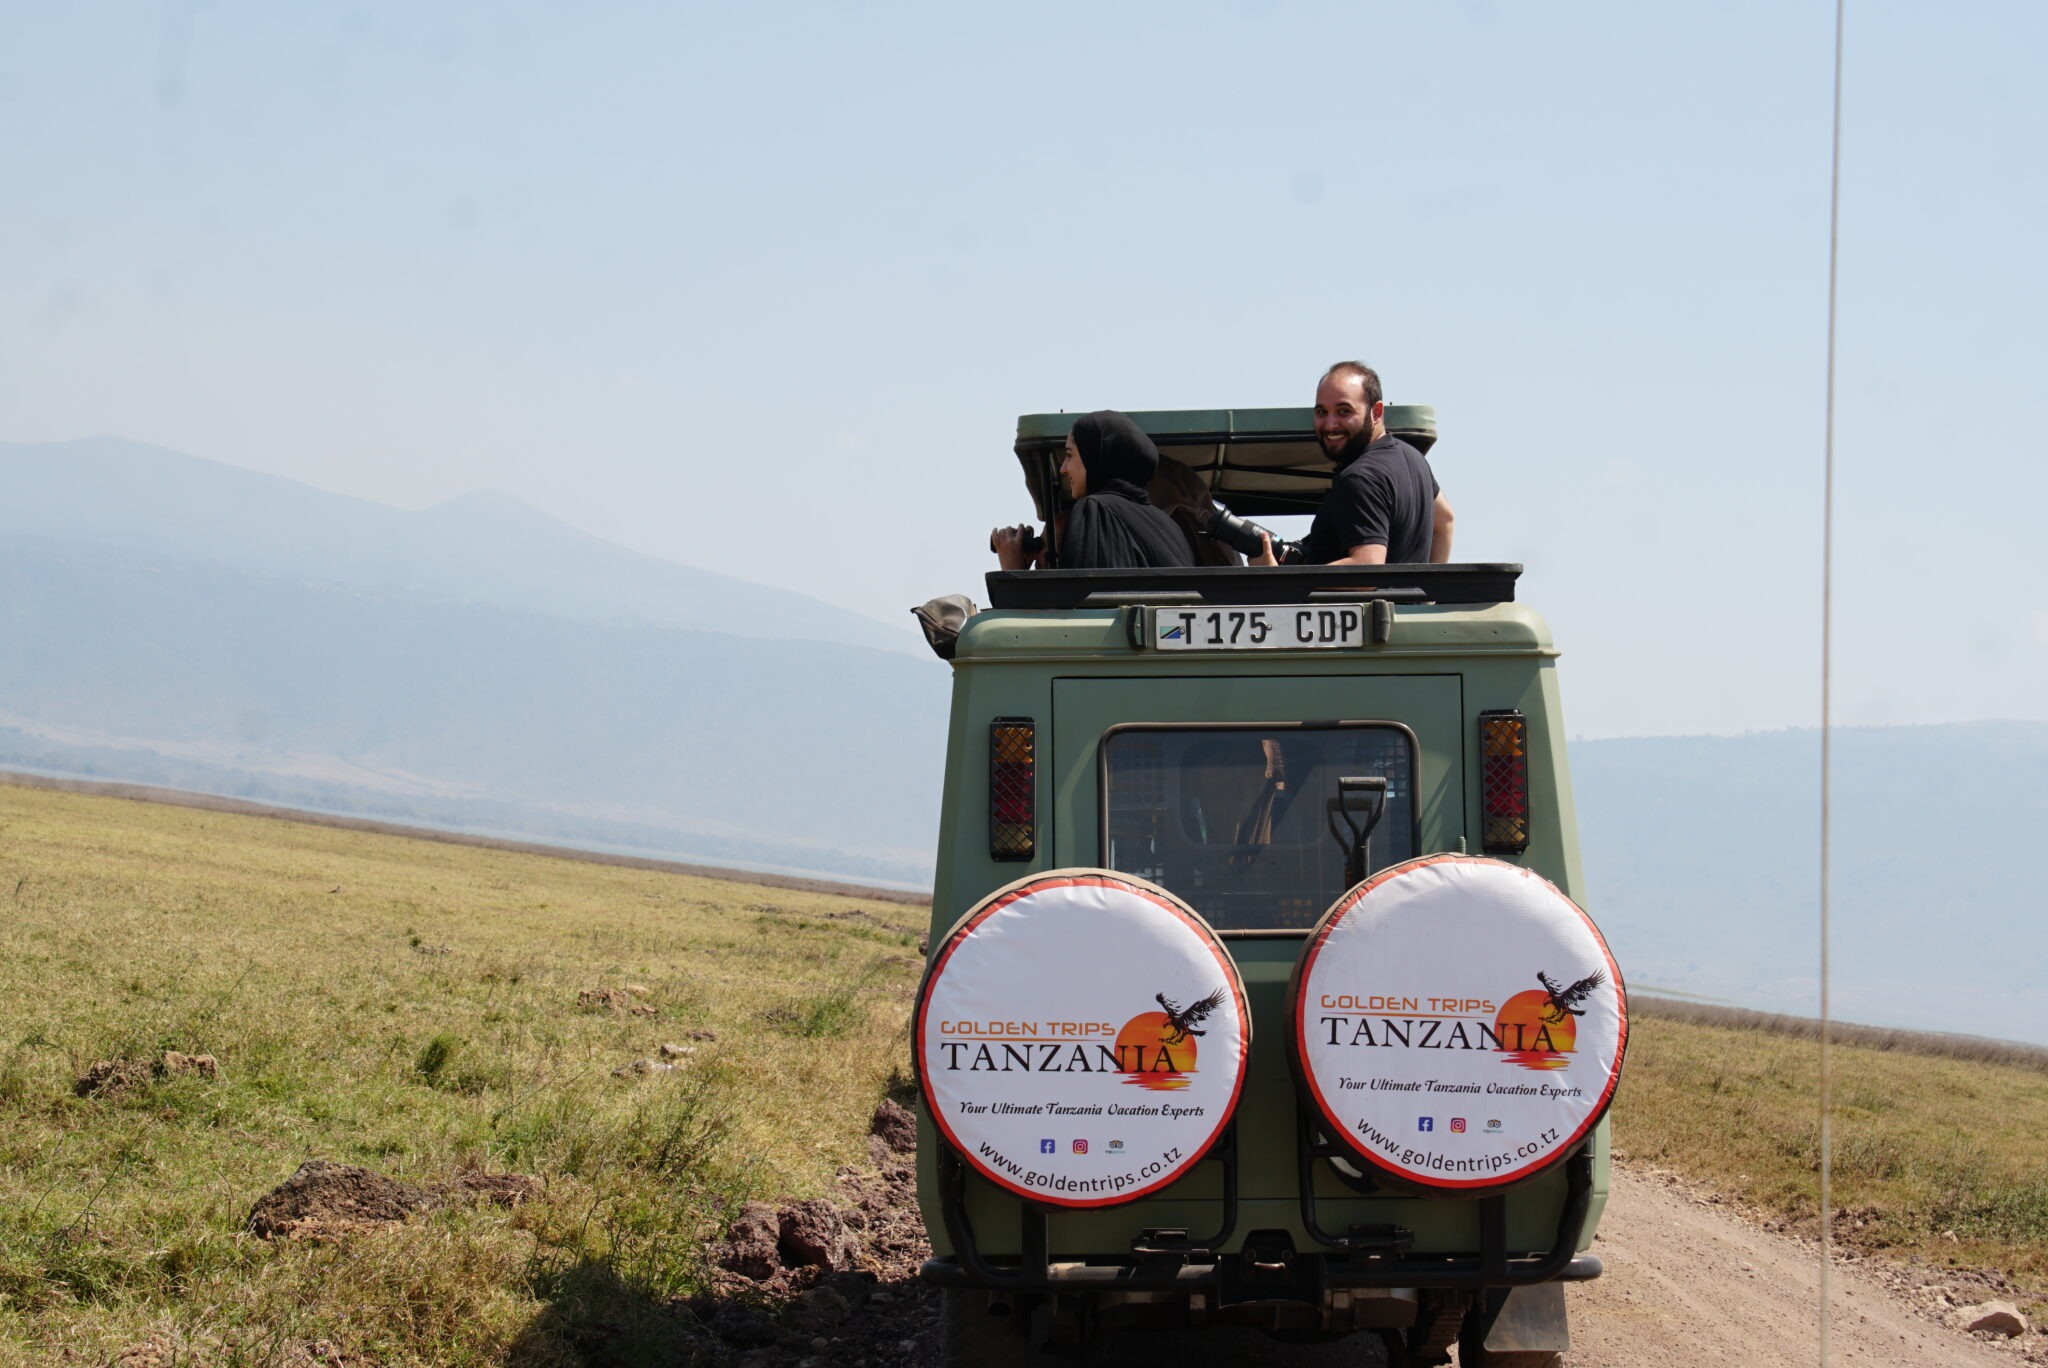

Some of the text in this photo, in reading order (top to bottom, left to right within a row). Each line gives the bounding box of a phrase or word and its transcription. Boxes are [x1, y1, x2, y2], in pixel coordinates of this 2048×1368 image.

[1296, 610, 1358, 643] CDP
[1320, 994, 1496, 1013] GOLDEN TRIPS
[940, 1021, 1116, 1036] GOLDEN TRIPS
[1320, 1017, 1558, 1052] TANZANIA
[940, 1043, 1179, 1073] TANZANIA
[1338, 1077, 1582, 1100] Your Ultimate Tanzania Vacation Experts
[959, 1102, 1205, 1120] Your Ultimate Tanzania Vacation Experts
[1357, 1118, 1560, 1172] www.goldentrips.co.tz
[979, 1141, 1183, 1192] www.goldentrips.co.tz
